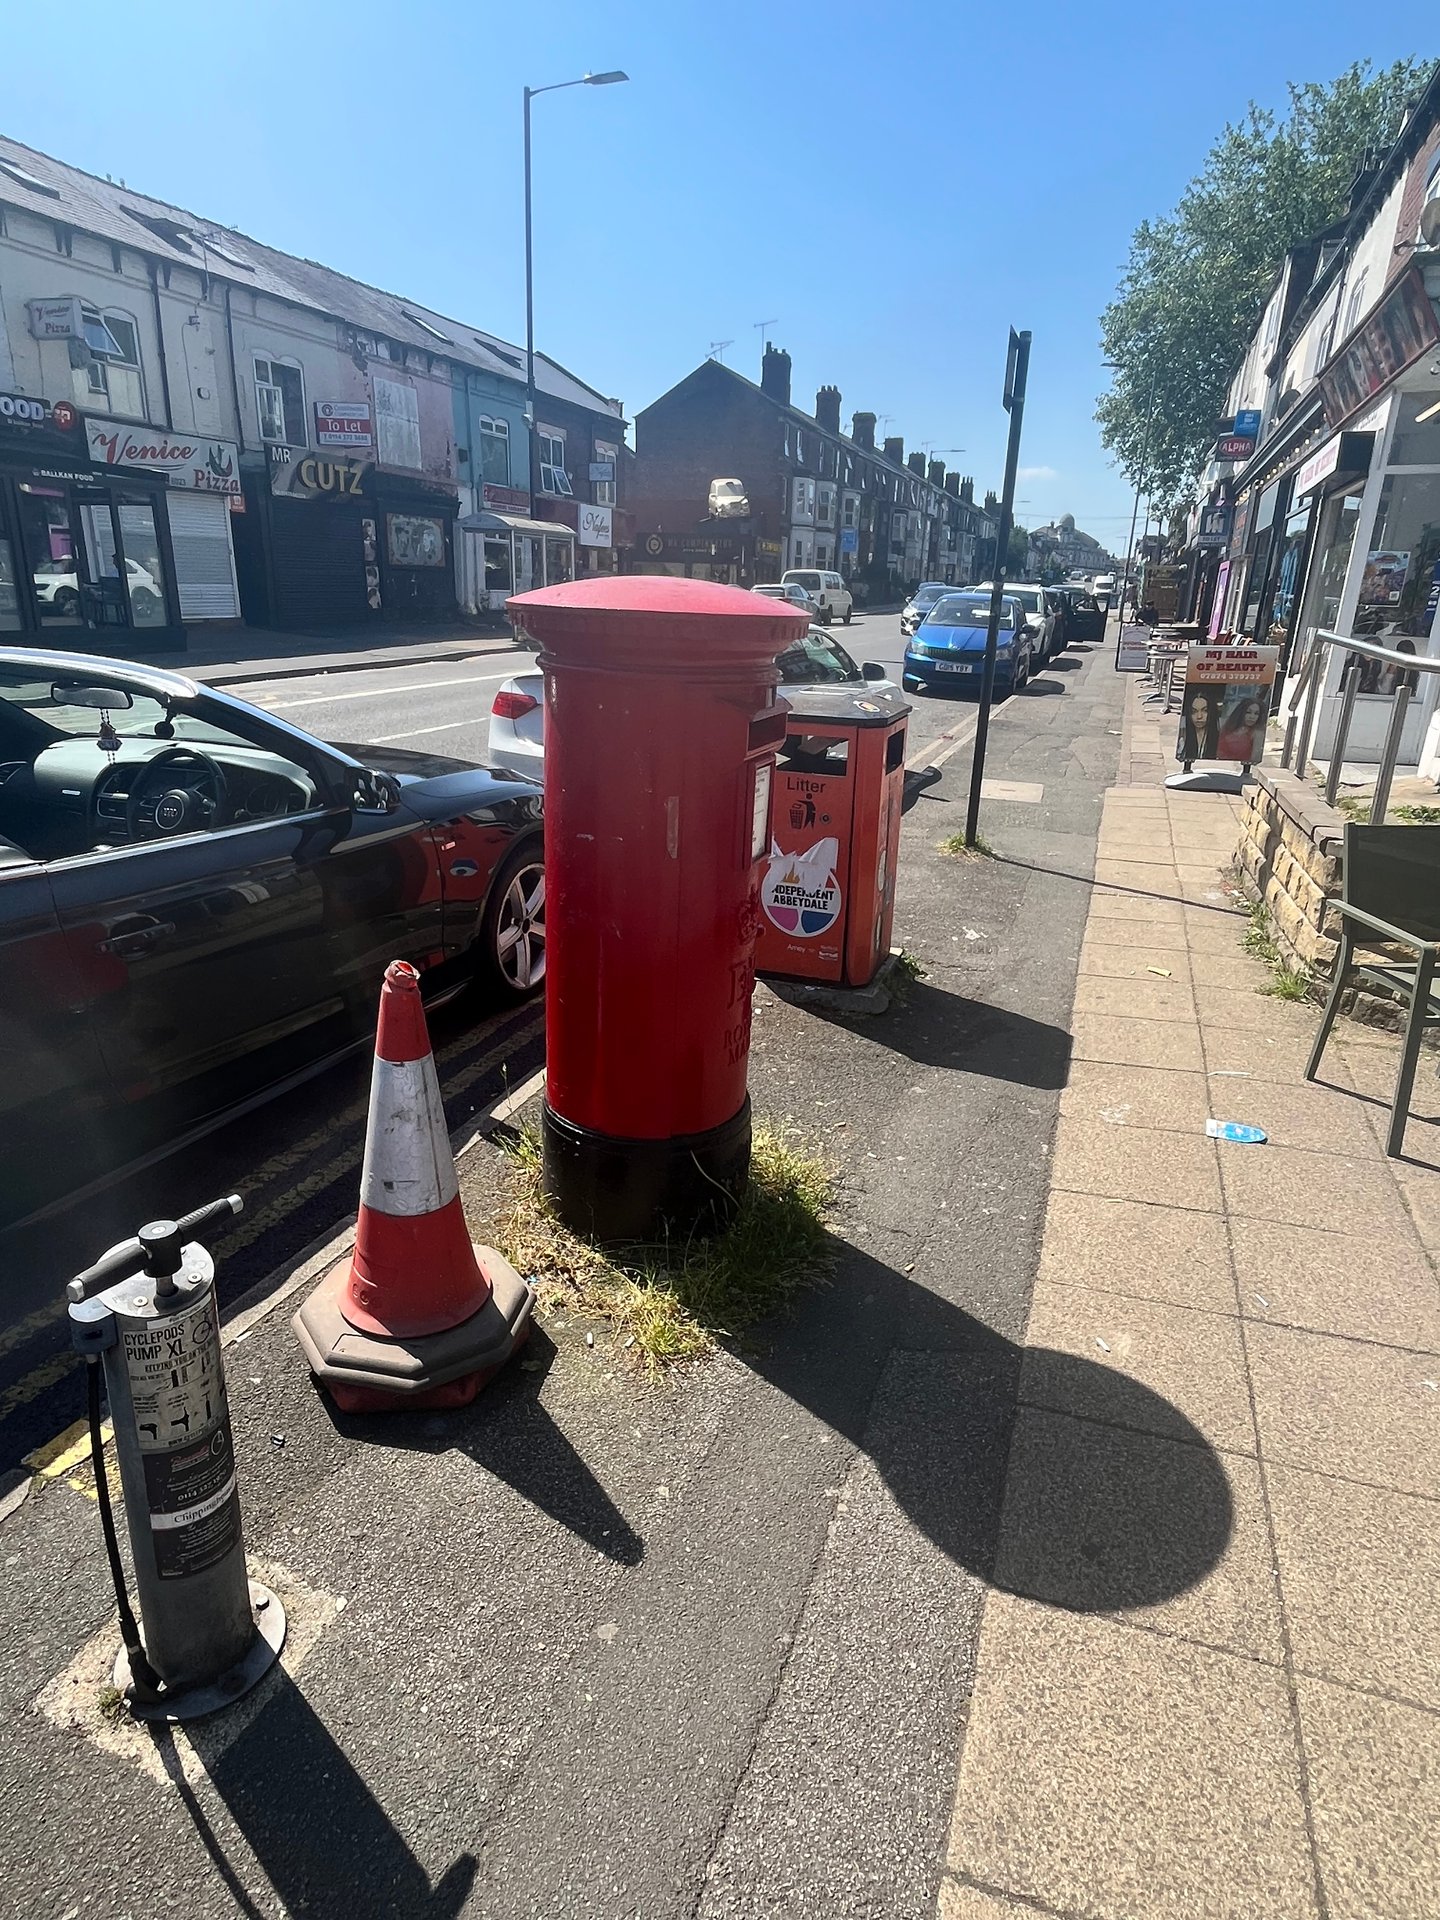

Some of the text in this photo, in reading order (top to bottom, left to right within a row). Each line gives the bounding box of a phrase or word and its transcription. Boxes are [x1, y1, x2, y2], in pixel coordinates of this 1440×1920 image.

[45, 322, 70, 334] Pizza
[326, 419, 362, 432] To Let
[92, 432, 199, 464] Venice
[271, 446, 291, 463] MR
[1221, 441, 1253, 453] ALPHA
[74, 473, 94, 482] FOOD
[193, 469, 240, 492] Pizza
[300, 458, 363, 495] CUTZ
[1205, 650, 1258, 660] MJ HAIR
[1196, 663, 1267, 672] OF BEAUTY
[786, 776, 827, 795] Litter
[773, 894, 828, 911] ABBEYDALE
[123, 1323, 185, 1346] CYCLEPODS
[126, 1338, 187, 1361] PUMP XL
